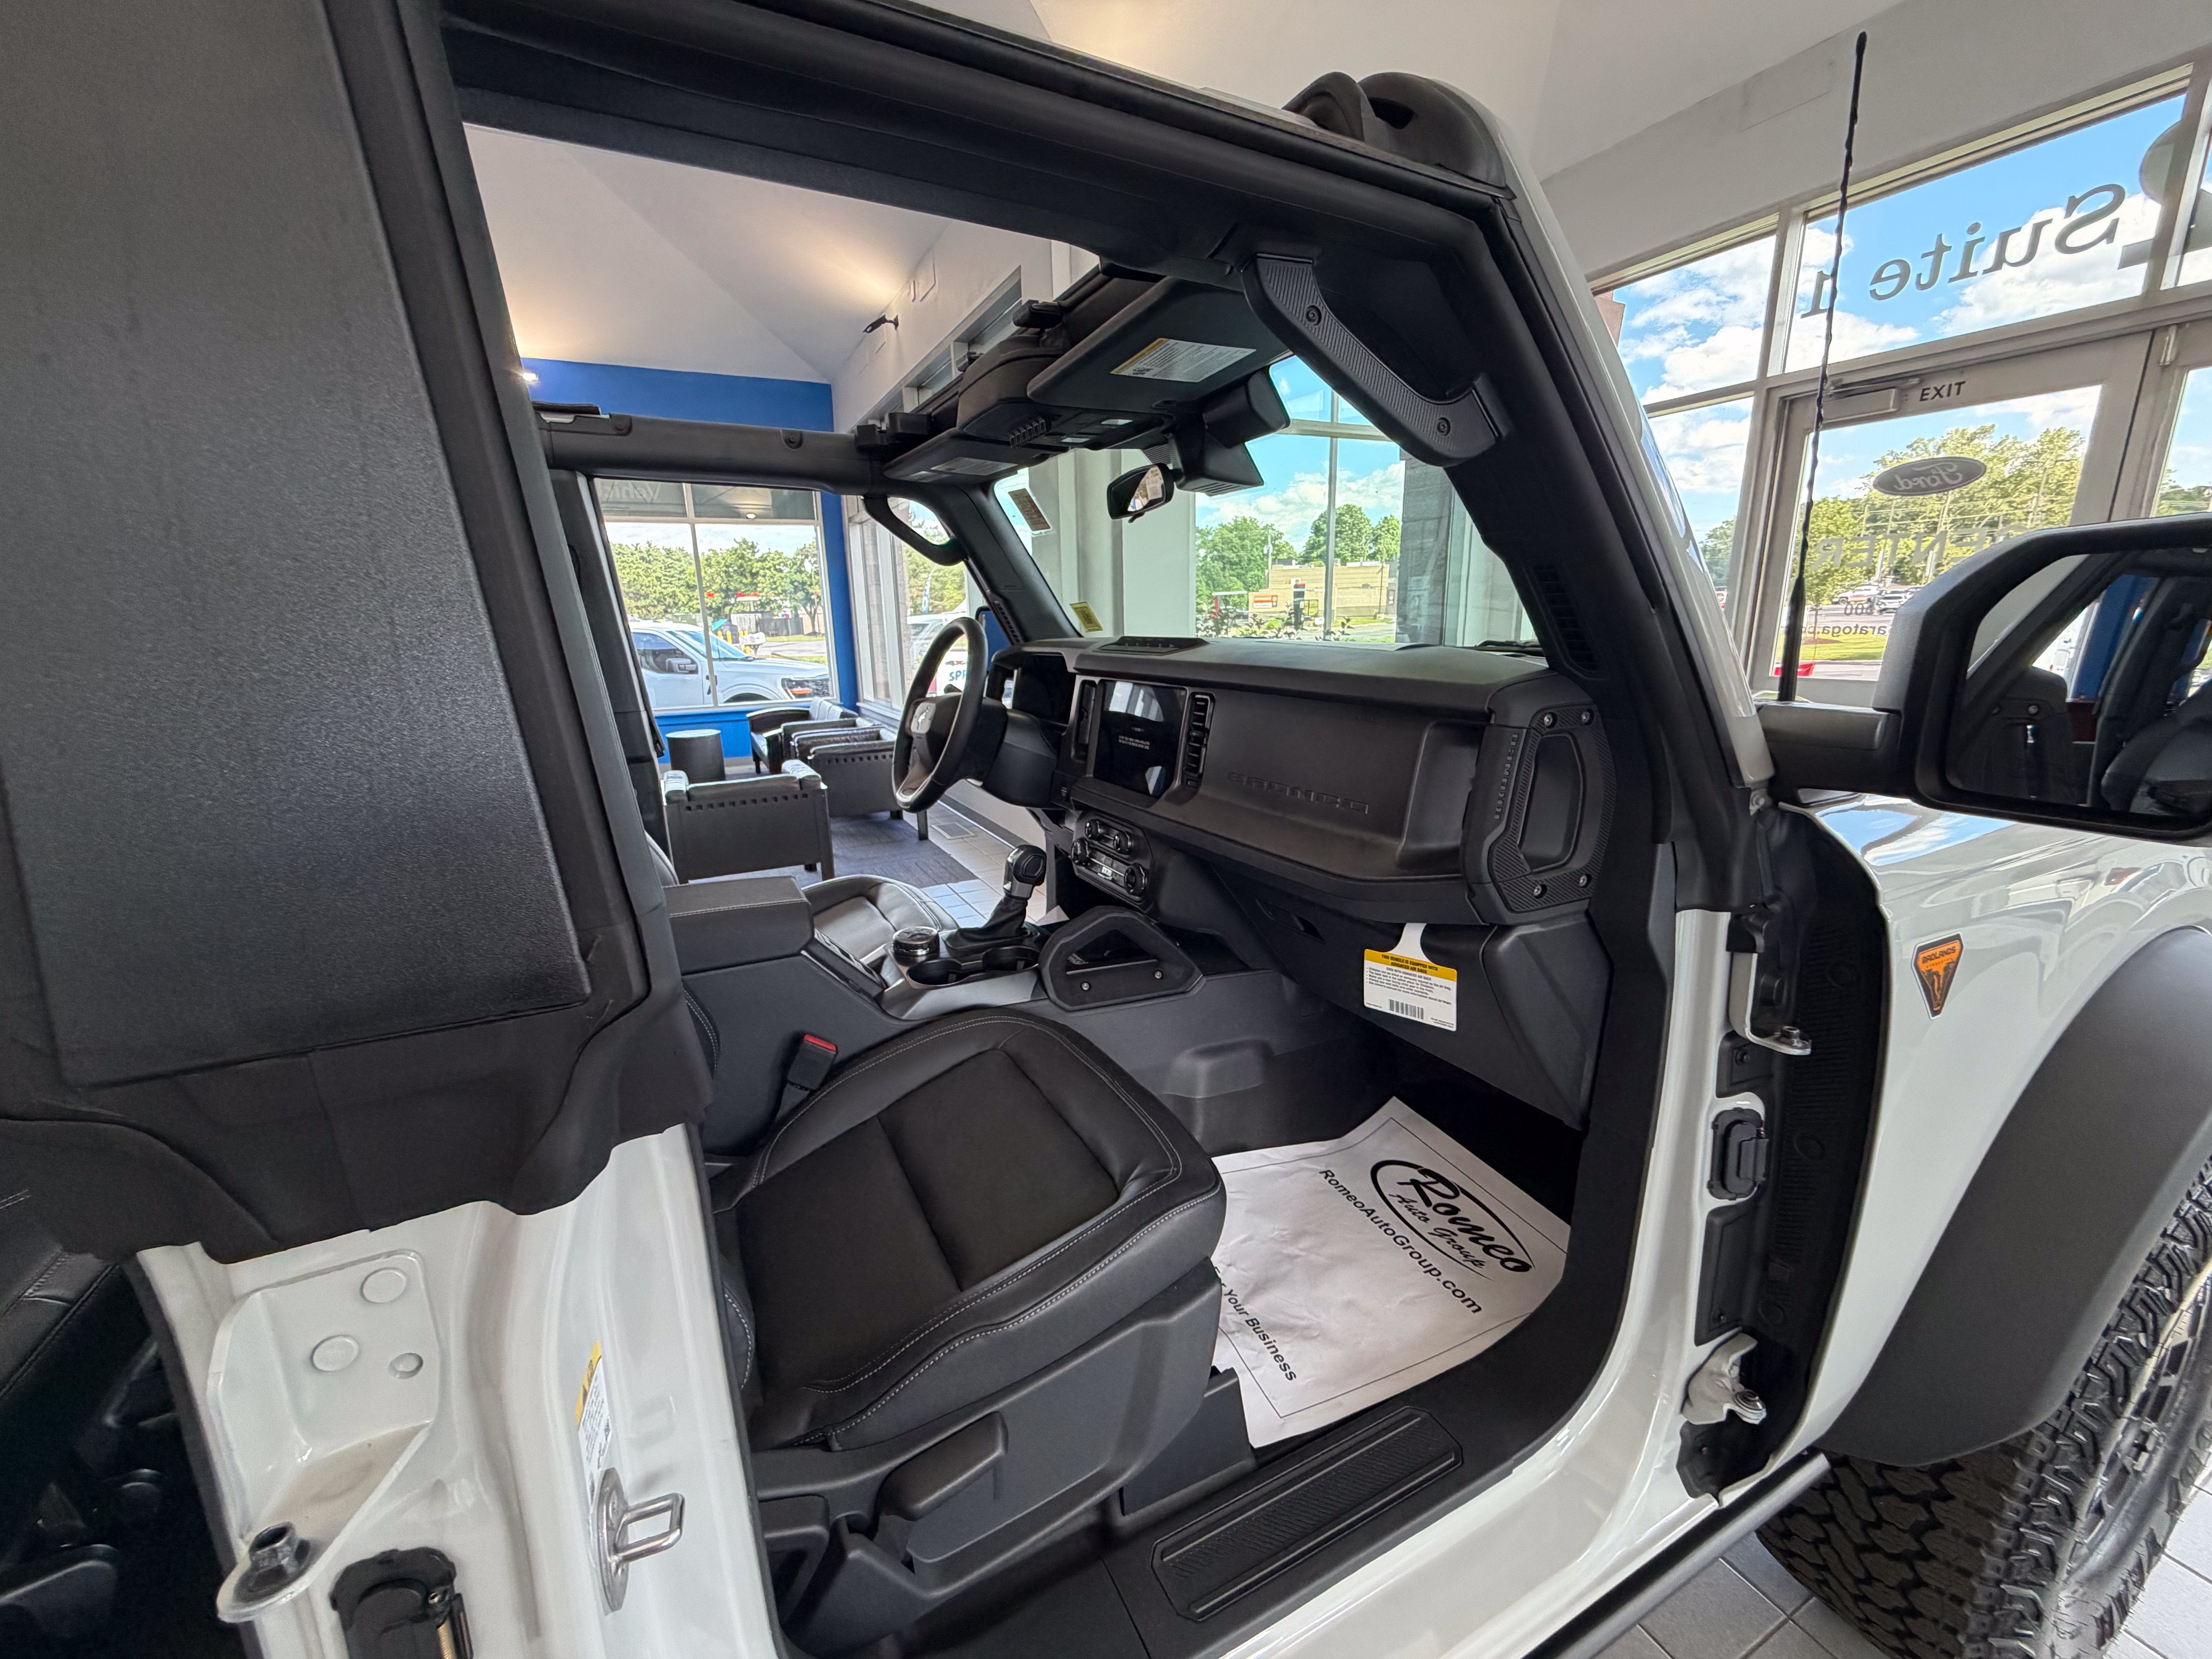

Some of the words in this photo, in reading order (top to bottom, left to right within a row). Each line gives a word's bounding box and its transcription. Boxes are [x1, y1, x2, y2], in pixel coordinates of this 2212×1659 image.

[1920, 381, 1966, 402] EXIT
[1319, 1169, 1482, 1314] RomeoAutoGroup.com
[1388, 1194, 1431, 1224] Auto
[1427, 1227, 1487, 1269] Group
[1396, 1168, 1532, 1272] Romeo
[1224, 1289, 1249, 1316] Your
[1245, 1317, 1297, 1381] Business
